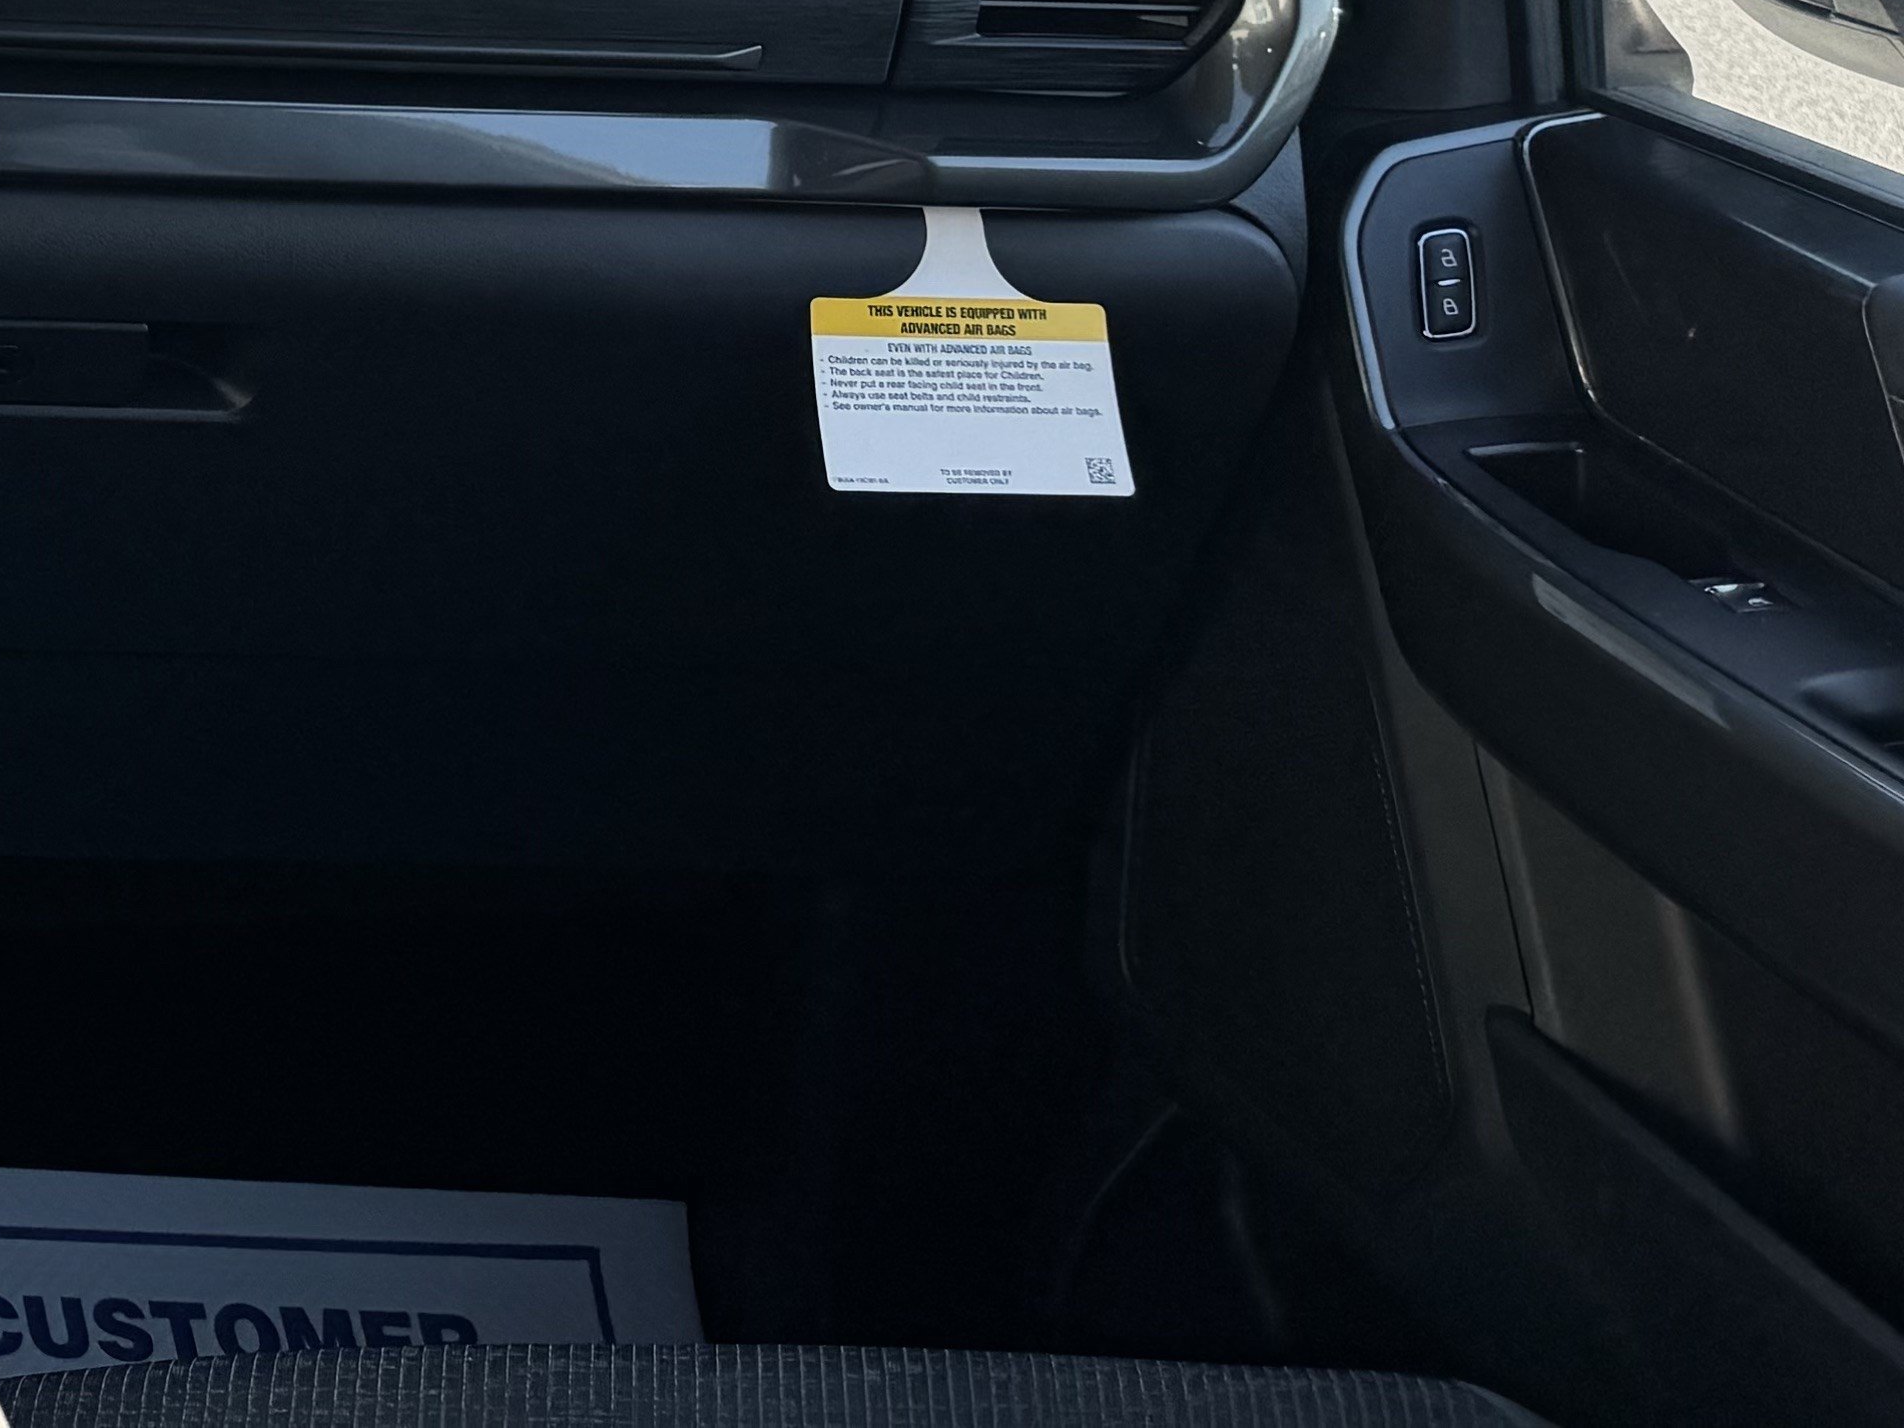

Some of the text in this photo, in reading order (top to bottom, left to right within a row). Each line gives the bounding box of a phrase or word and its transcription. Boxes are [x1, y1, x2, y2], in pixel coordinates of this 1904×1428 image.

[868, 305, 1047, 320] THIS VEHICLE IS EQUIPPED WITH
[900, 322, 1016, 336] ADVANCED AIR BAGS
[887, 343, 1032, 356] EVEN WITH ADVANCED AIR BAGS
[828, 355, 868, 364] Children
[890, 356, 902, 365] be
[905, 356, 930, 366] killed
[945, 358, 989, 369] seriously
[992, 359, 1024, 370] injured
[1027, 359, 1038, 370] by
[1041, 360, 1056, 369] the
[1058, 360, 1070, 369] air
[829, 367, 1044, 380] The back seat is the safest place for Children.
[830, 379, 857, 387] Never
[861, 379, 876, 389] put
[908, 380, 938, 391] facing
[940, 381, 964, 390] child
[966, 382, 986, 391] seat
[989, 382, 997, 391] in
[1000, 383, 1015, 391] the
